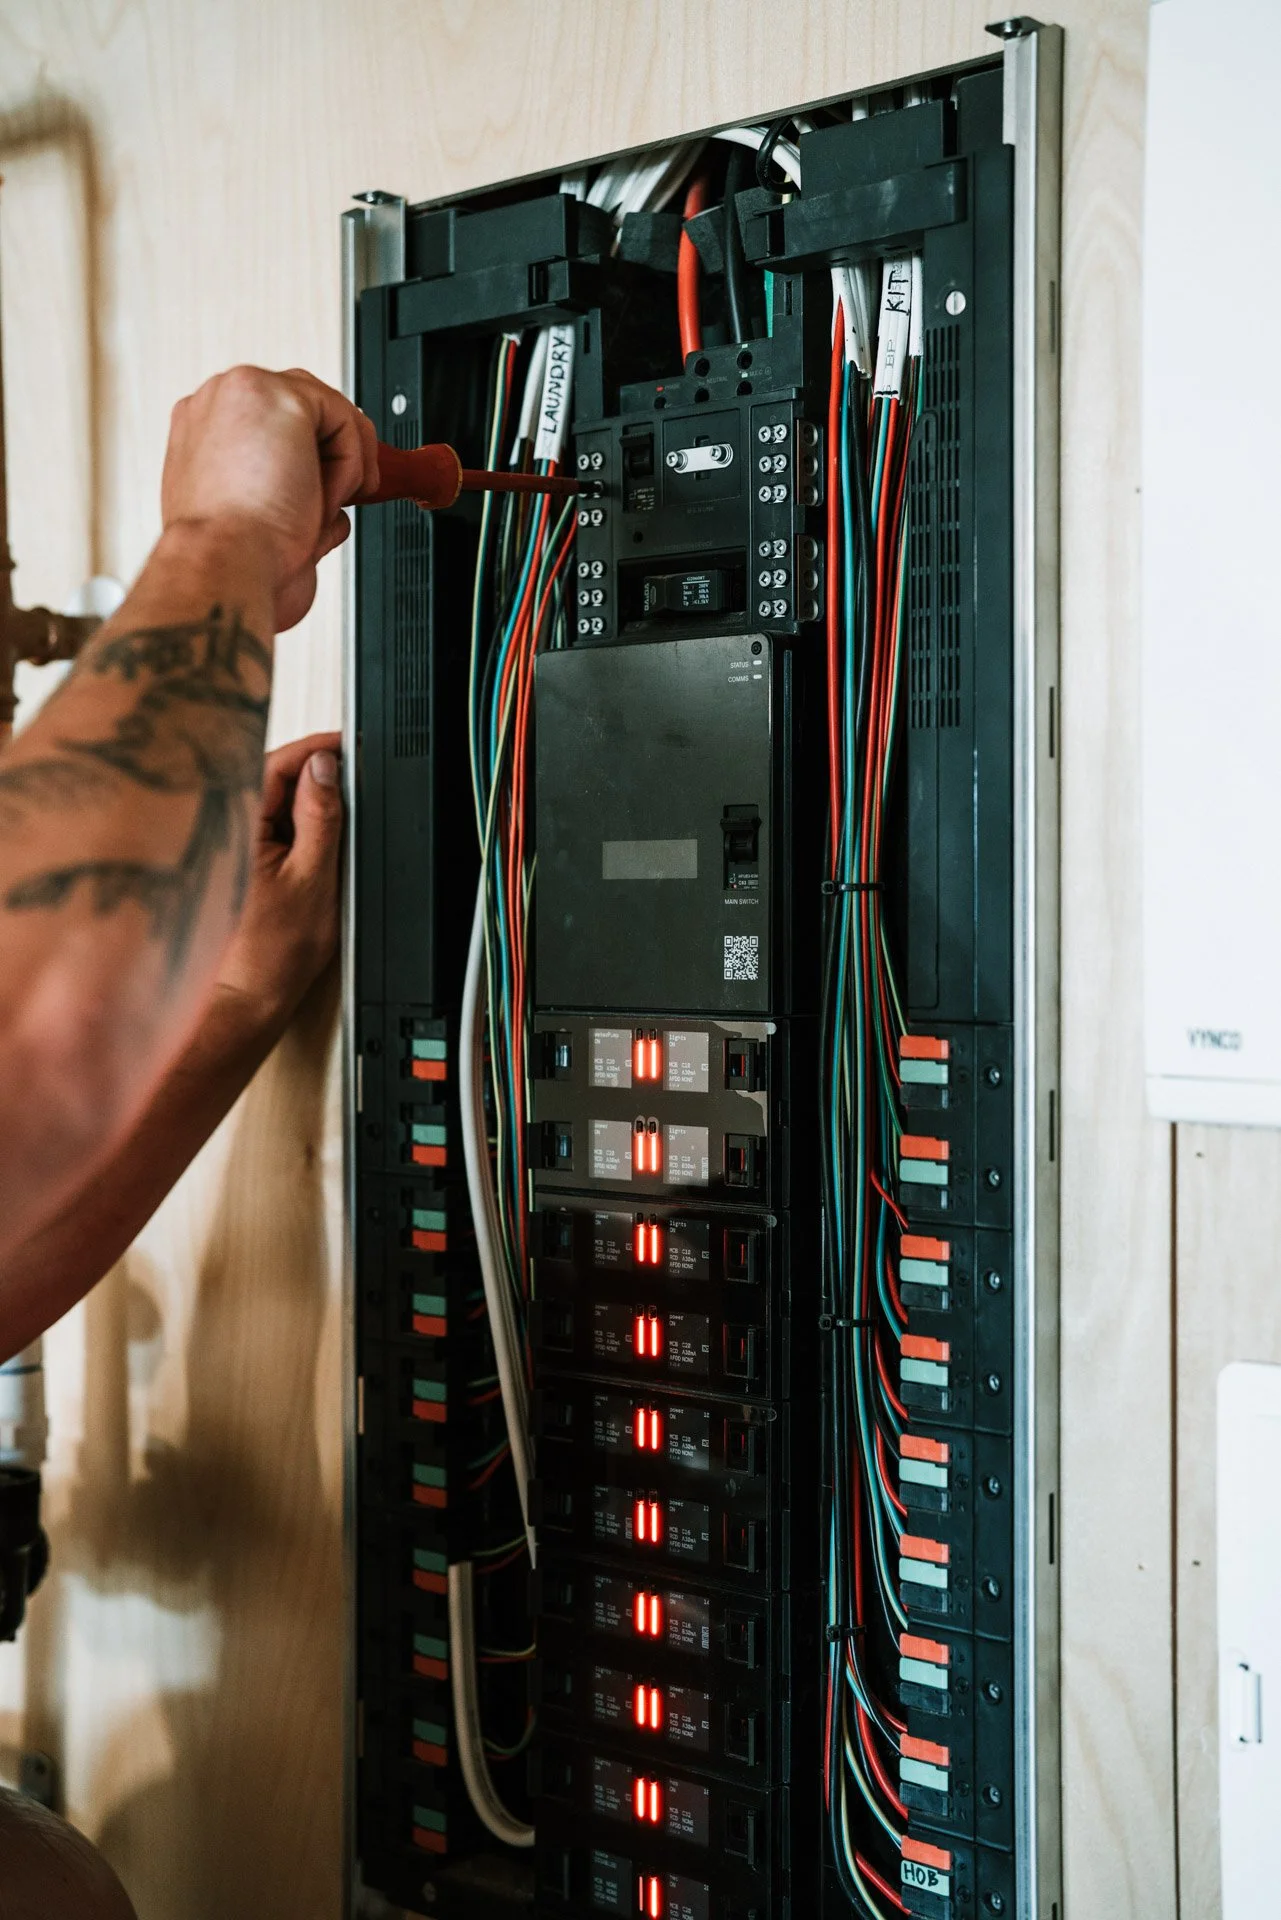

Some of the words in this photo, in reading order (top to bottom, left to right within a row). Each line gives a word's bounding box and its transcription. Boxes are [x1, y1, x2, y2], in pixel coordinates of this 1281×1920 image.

[885, 270, 911, 316] KIT
[543, 336, 573, 434] LAUNDRY
[903, 1862, 939, 1887] HOB
